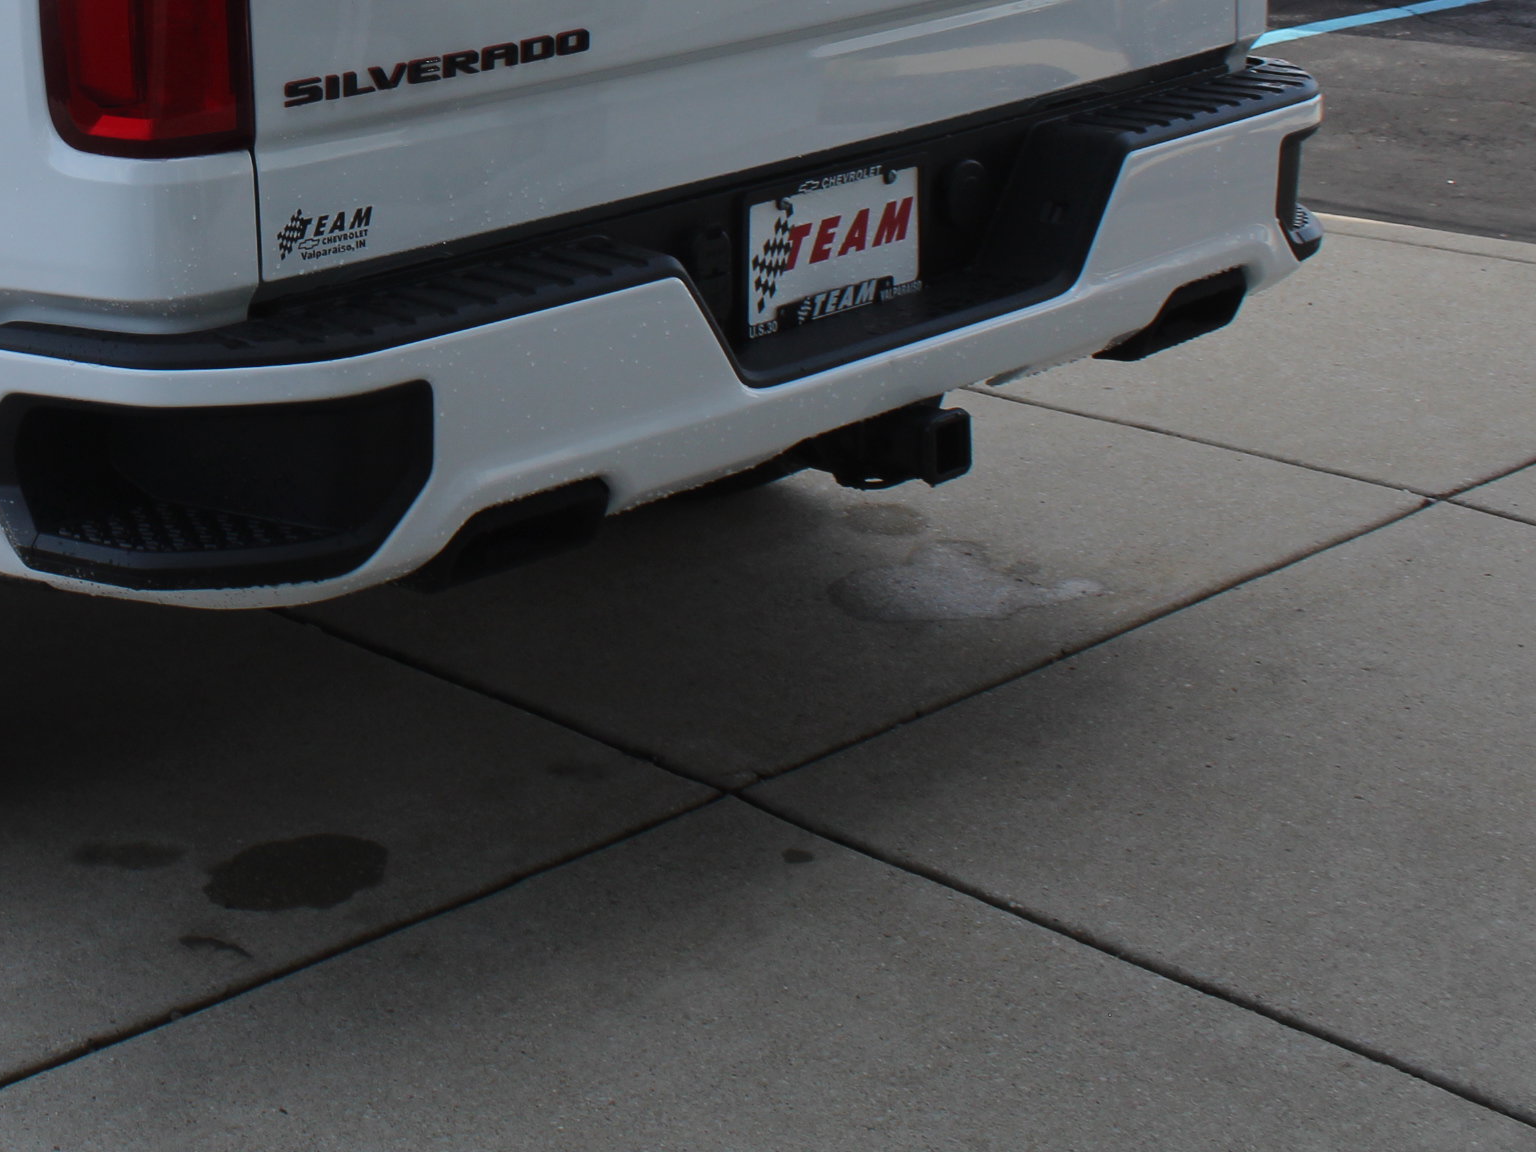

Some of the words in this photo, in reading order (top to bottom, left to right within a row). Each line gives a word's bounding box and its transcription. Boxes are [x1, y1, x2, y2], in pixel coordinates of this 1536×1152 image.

[283, 28, 591, 109] SILVERADO
[821, 165, 882, 189] CHEVROLET
[298, 206, 373, 239] TEAM
[322, 229, 368, 245] CHEVROLET
[783, 196, 913, 272] TEAM
[301, 244, 355, 260] Valparaiso,
[356, 239, 366, 248] IN
[812, 279, 878, 317] TEAM
